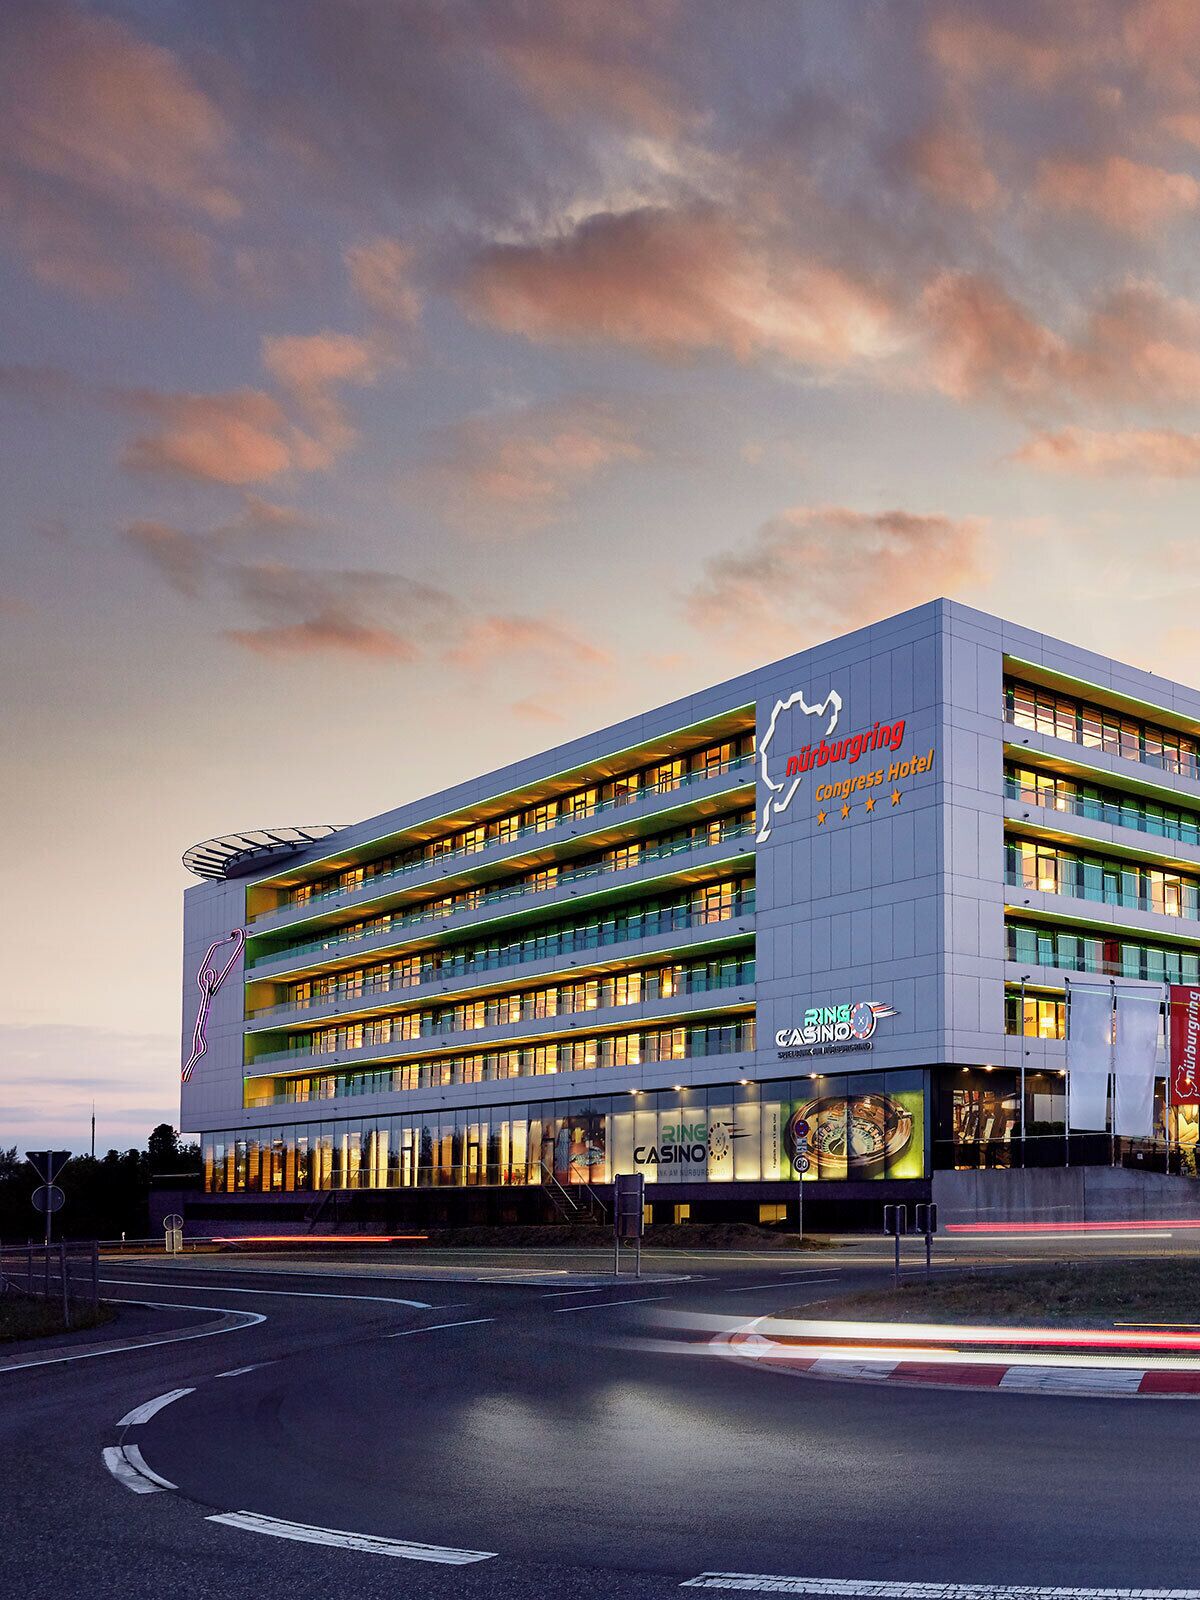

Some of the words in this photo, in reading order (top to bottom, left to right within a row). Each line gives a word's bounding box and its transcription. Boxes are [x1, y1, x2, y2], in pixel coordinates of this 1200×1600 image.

[786, 720, 905, 777] nürburgring
[815, 769, 884, 801] Congress
[887, 748, 934, 783] Hotel
[804, 1004, 852, 1026] RING
[776, 1023, 851, 1048] CASINO
[662, 1124, 707, 1143] RING
[633, 1144, 706, 1164] CASINO
